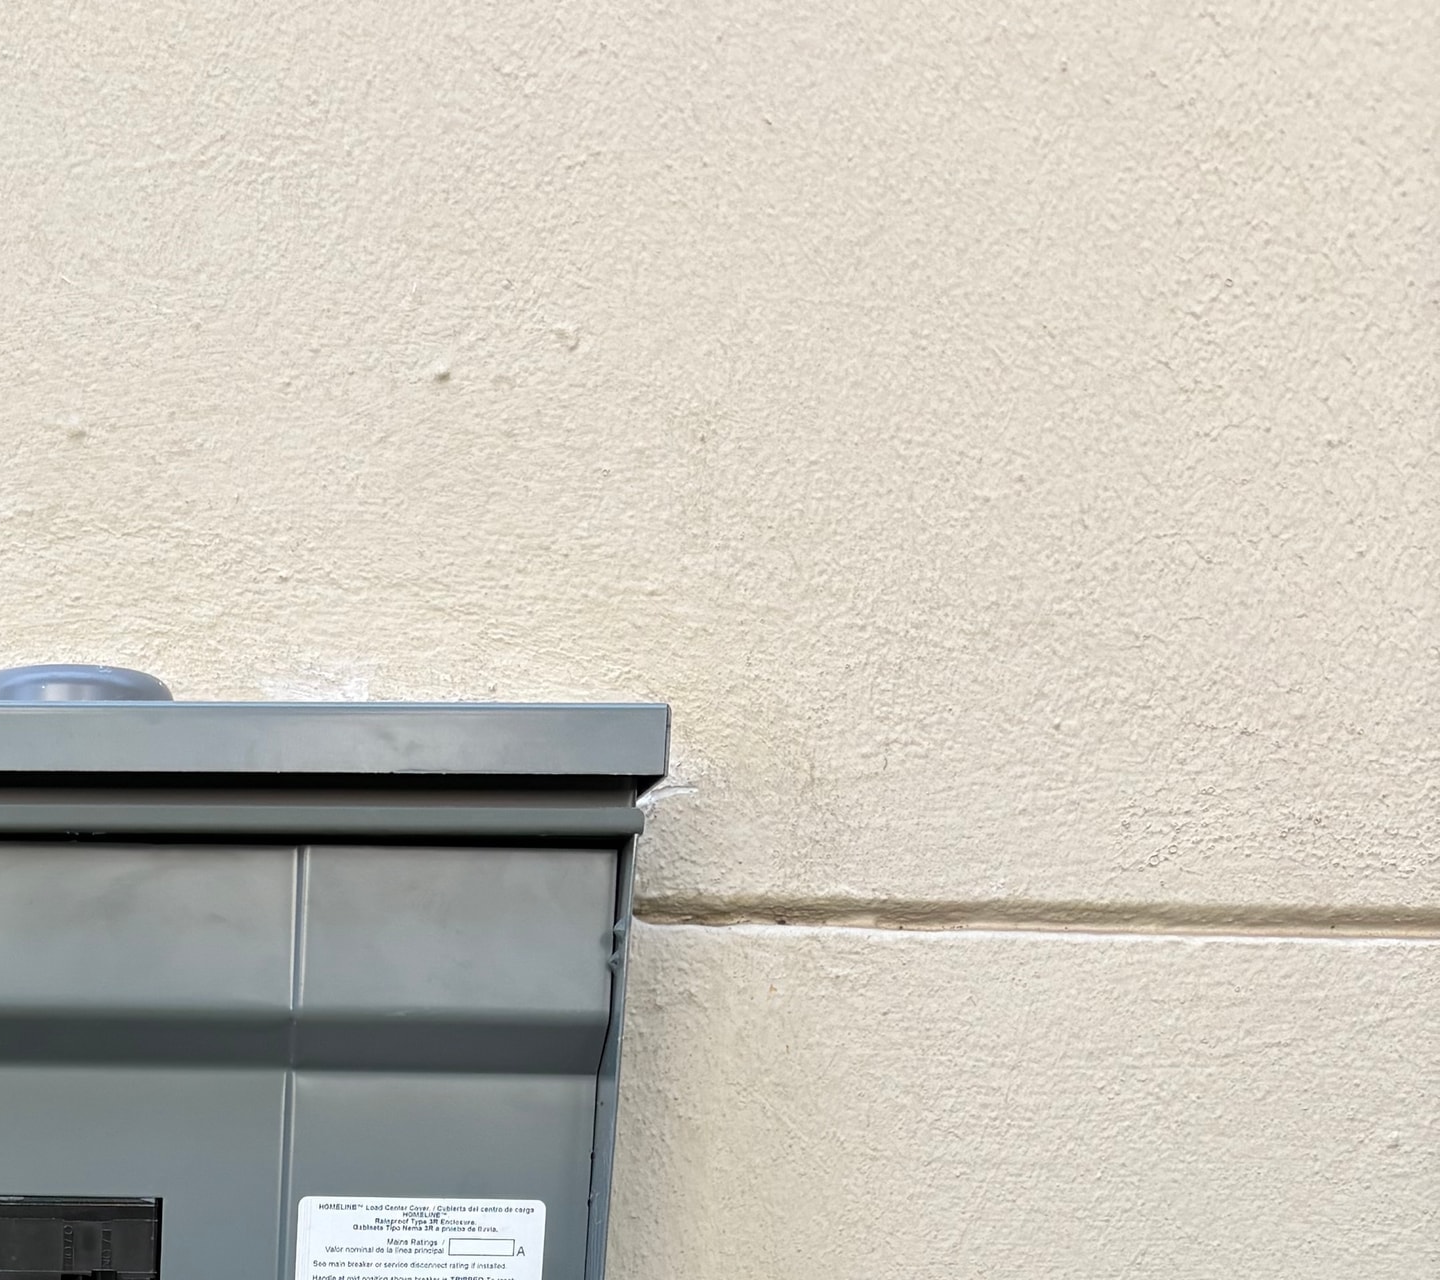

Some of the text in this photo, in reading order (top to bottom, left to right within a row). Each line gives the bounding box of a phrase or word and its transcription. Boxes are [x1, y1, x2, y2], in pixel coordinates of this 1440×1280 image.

[411, 1218, 428, 1226] Type
[411, 1239, 438, 1247] Ratings
[516, 1246, 525, 1257] A
[347, 1260, 373, 1268] breaker
[410, 1261, 447, 1269] disconnect
[449, 1262, 469, 1271] rating
